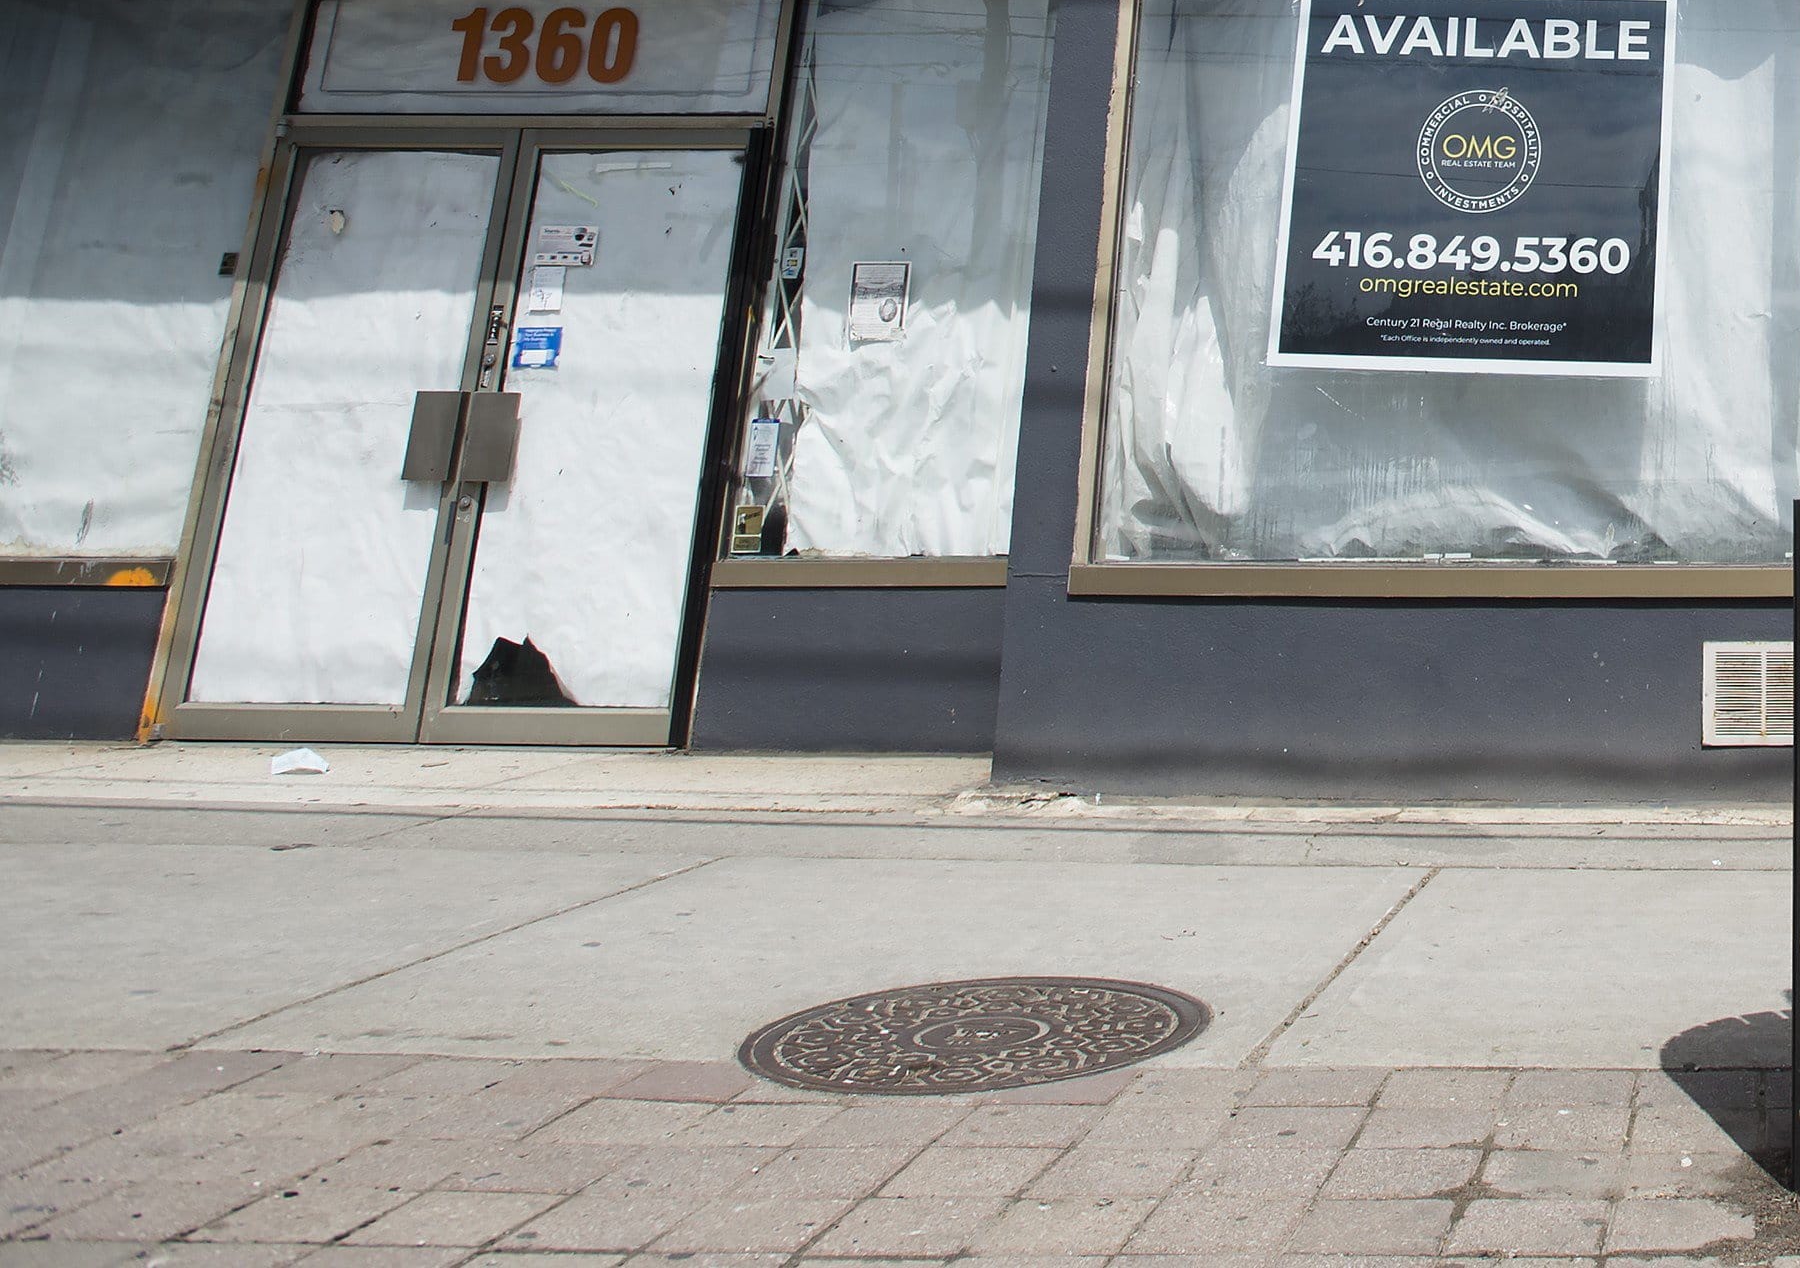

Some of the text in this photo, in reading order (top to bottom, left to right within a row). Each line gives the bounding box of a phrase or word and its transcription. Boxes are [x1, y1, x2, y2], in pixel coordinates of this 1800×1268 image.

[451, 6, 640, 84] 1360
[1319, 13, 1651, 61] AVAILABLE
[1421, 97, 1470, 165] COMMERCIAL
[1443, 134, 1516, 159] OMG
[1441, 159, 1462, 167] REAL
[1464, 160, 1492, 168] ESTATE
[1435, 185, 1519, 209] INVESTMENTS
[1310, 230, 1631, 275] 416.849.5360
[1358, 276, 1579, 298] omgrealestate.com
[1366, 316, 1408, 330] Century
[1410, 318, 1420, 327] 21
[1422, 319, 1451, 330] Regal
[1455, 320, 1486, 332] Realty
[1489, 321, 1507, 330] Inc.
[1401, 335, 1421, 343] Office
[1429, 336, 1478, 345] independently
